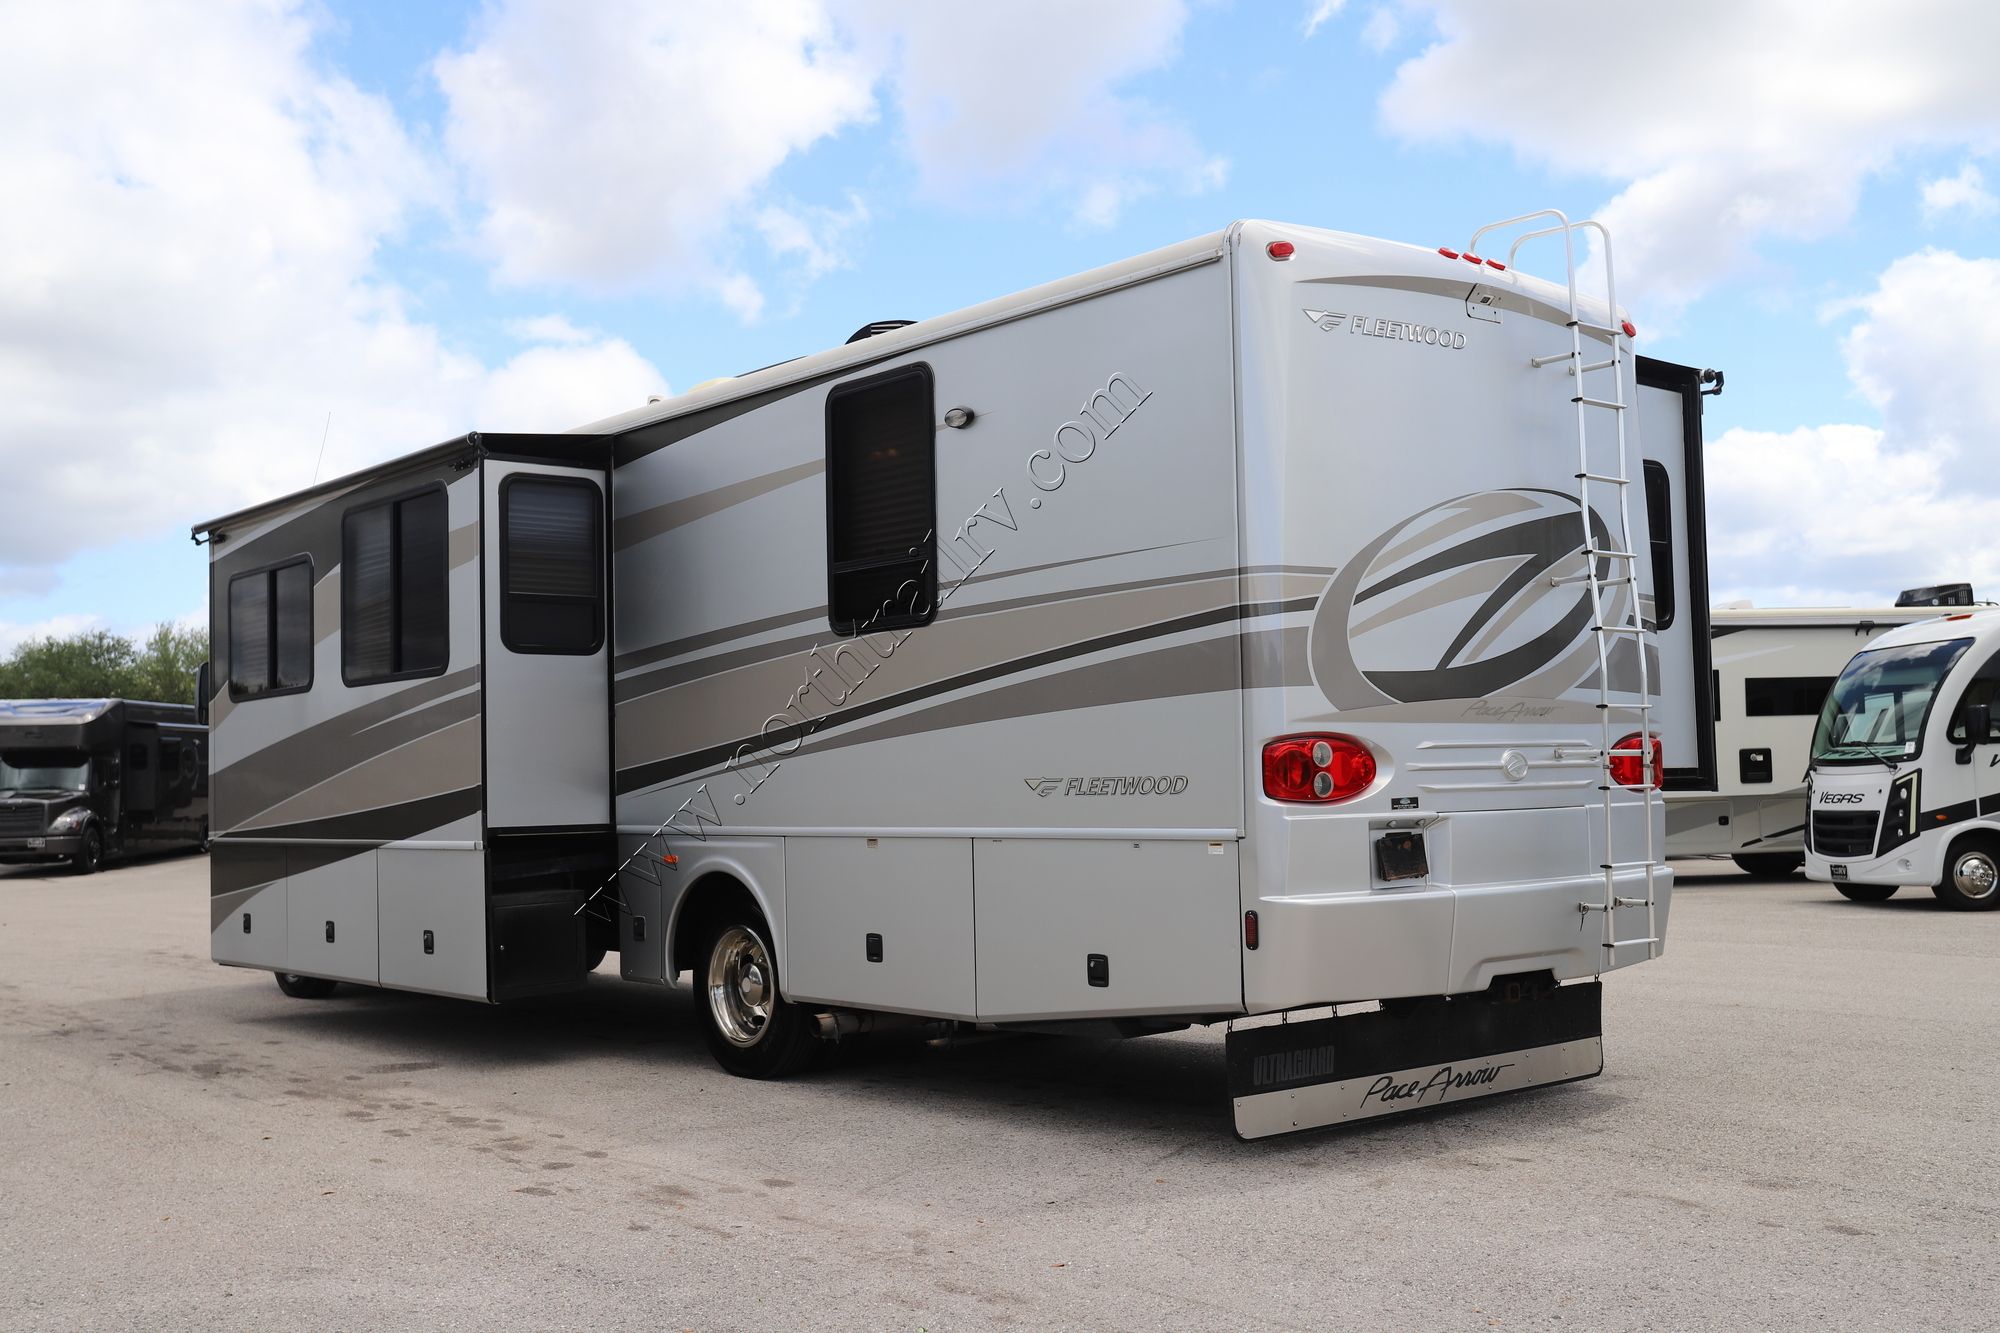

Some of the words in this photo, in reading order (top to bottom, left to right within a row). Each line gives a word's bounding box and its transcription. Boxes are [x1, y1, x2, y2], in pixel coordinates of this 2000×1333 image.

[1350, 315, 1467, 350] FLEETWOOD
[1064, 775, 1189, 796] FLEETWOOD
[1819, 791, 1865, 804] VEGAS
[1253, 1045, 1335, 1086] ULTRAGUARD
[1360, 1076, 1420, 1108] Pace
[1417, 1063, 1515, 1104] Arrow
